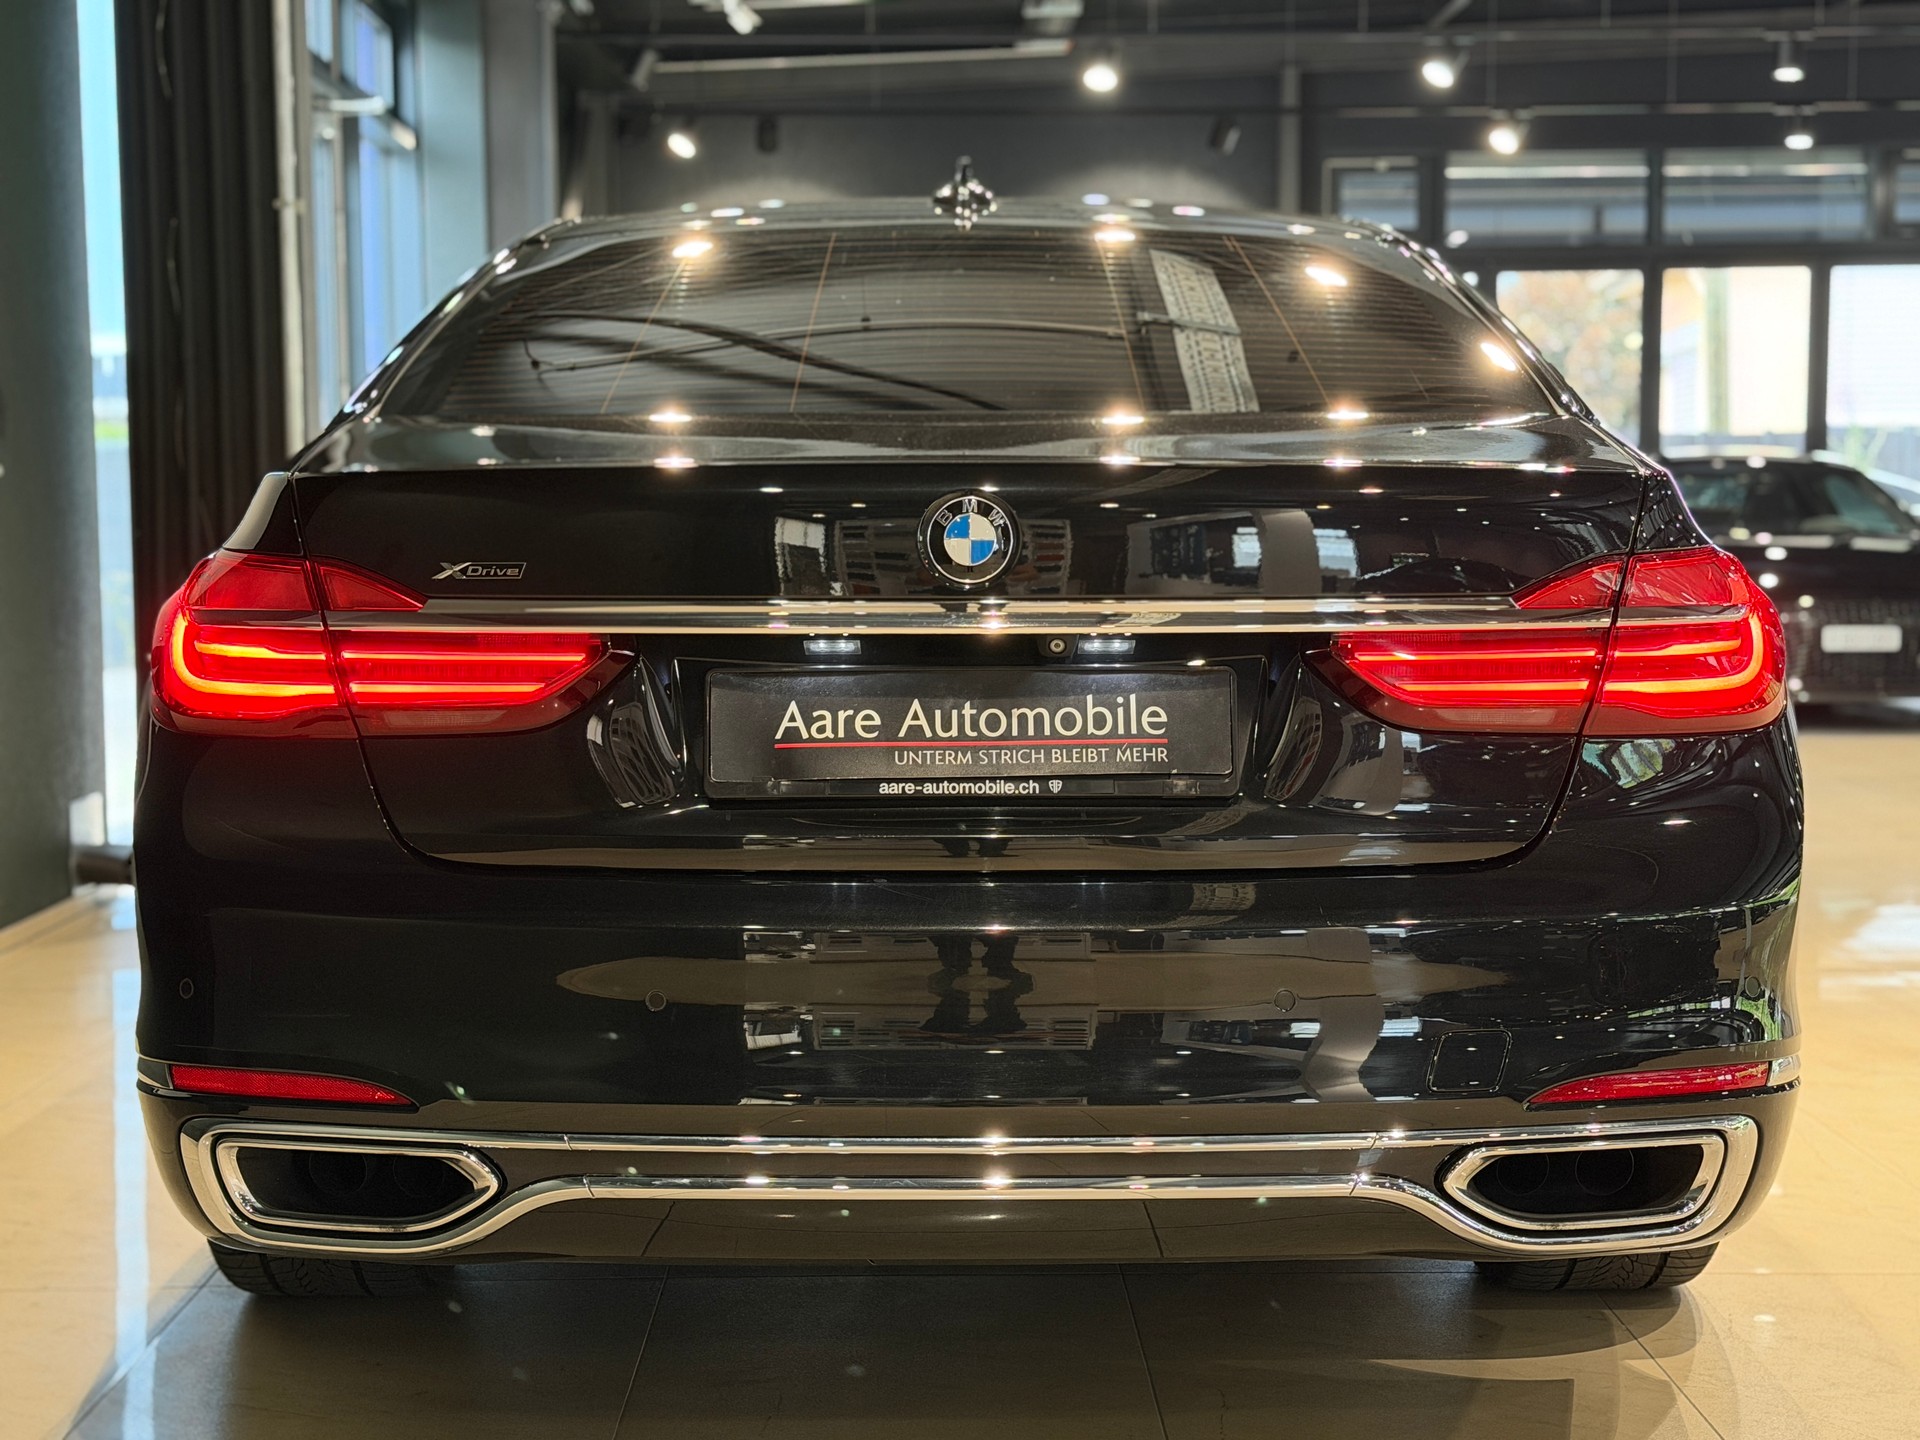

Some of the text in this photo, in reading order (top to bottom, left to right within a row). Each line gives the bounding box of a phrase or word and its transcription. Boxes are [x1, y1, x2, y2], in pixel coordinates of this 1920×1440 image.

[936, 498, 1005, 527] BMW
[774, 693, 1168, 740] Aare Automobile
[894, 750, 972, 765] UNTERM
[979, 749, 1044, 764] STRICH
[1052, 747, 1110, 763] BLEIBT
[879, 780, 1040, 795] aare-automobile.ch
